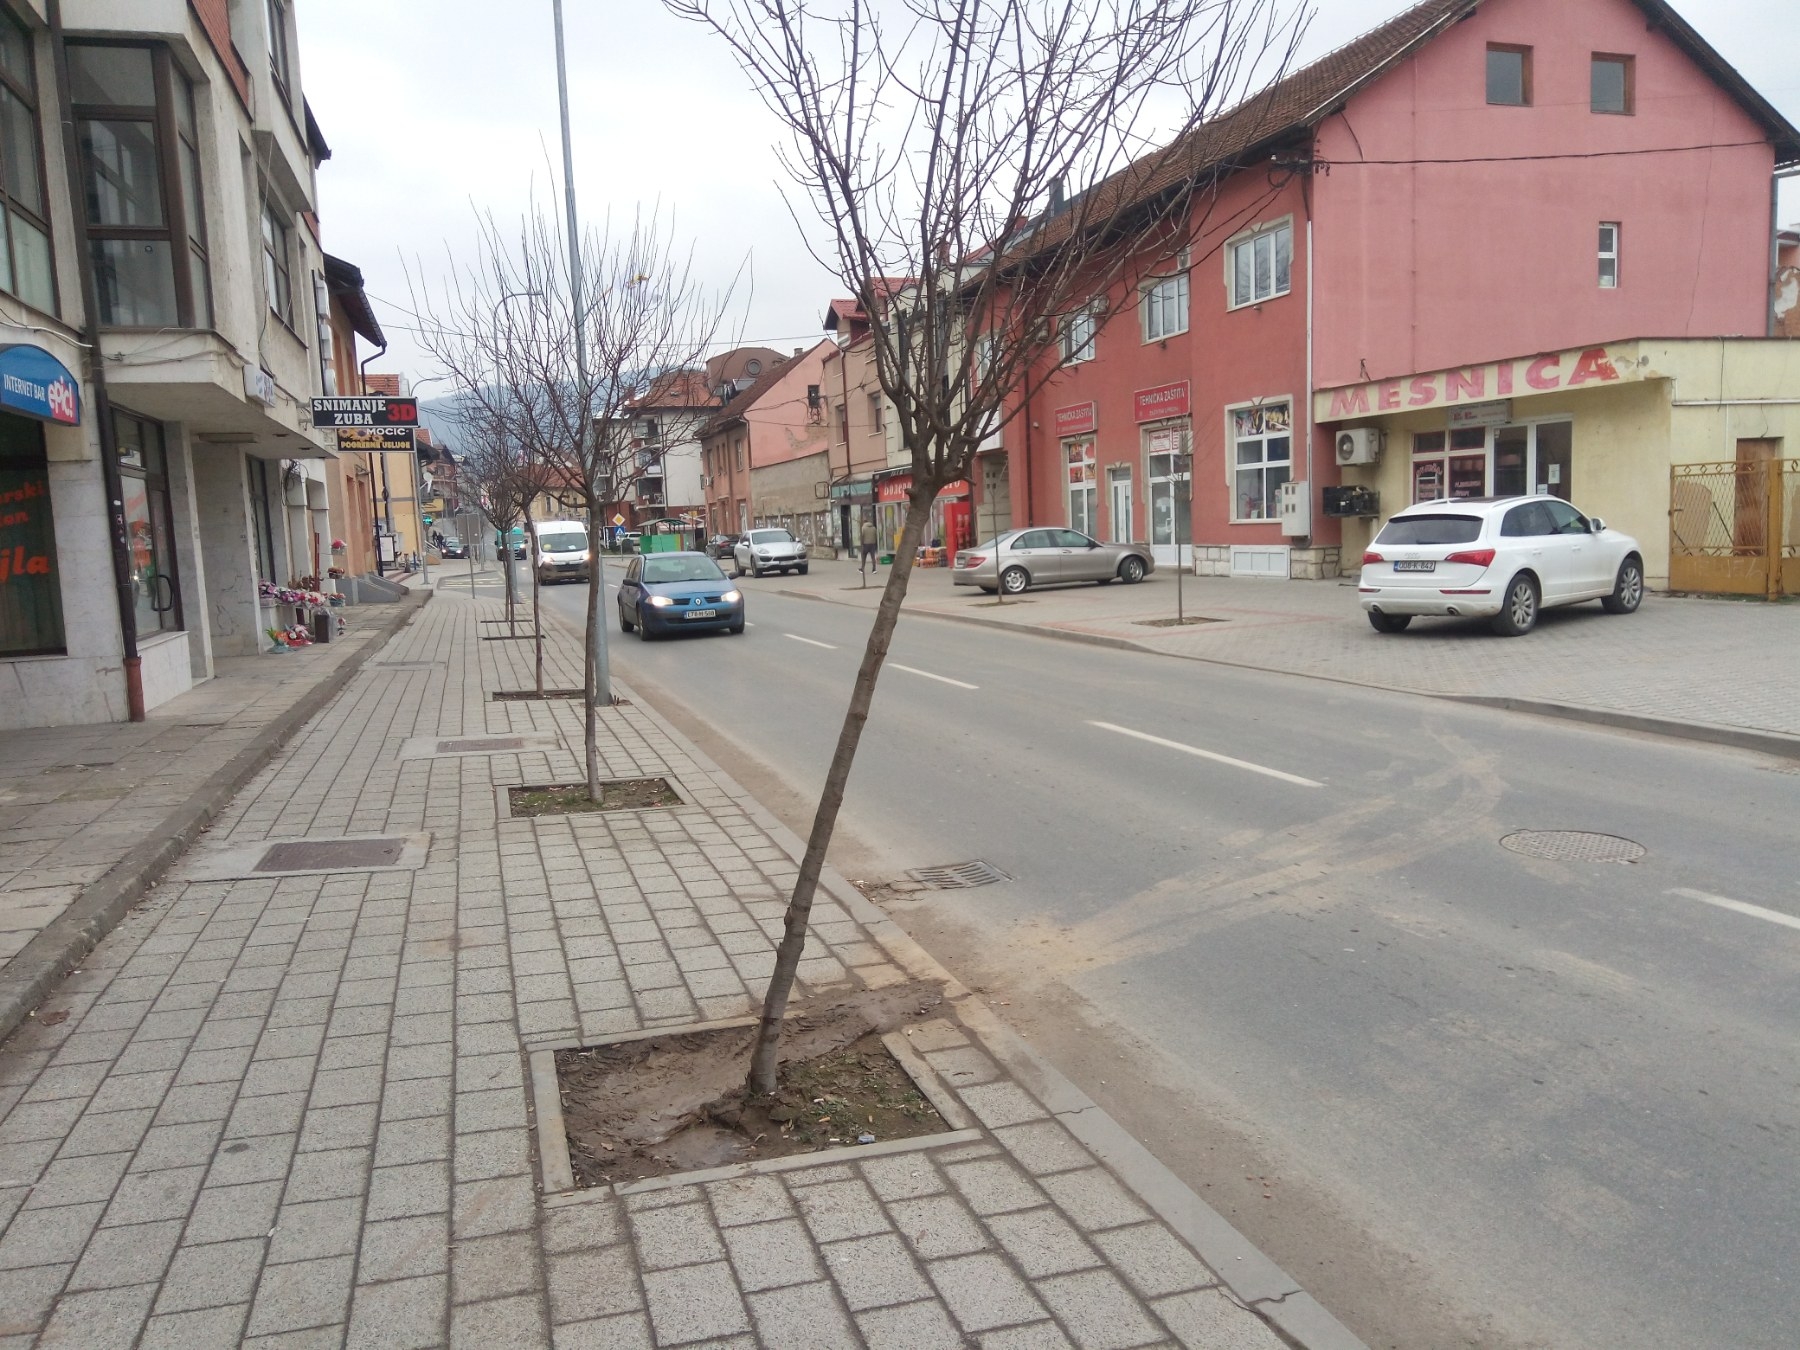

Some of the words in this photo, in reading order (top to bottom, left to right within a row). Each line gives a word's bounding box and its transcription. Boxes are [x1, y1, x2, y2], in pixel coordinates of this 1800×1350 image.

[3, 373, 33, 397] INTERNET
[33, 384, 46, 402] BAR
[1329, 347, 1620, 417] MESNICA
[48, 375, 73, 418] epic!
[313, 399, 387, 413] SNIMANJE
[334, 413, 374, 425] ZUBA
[387, 403, 416, 422] 3D
